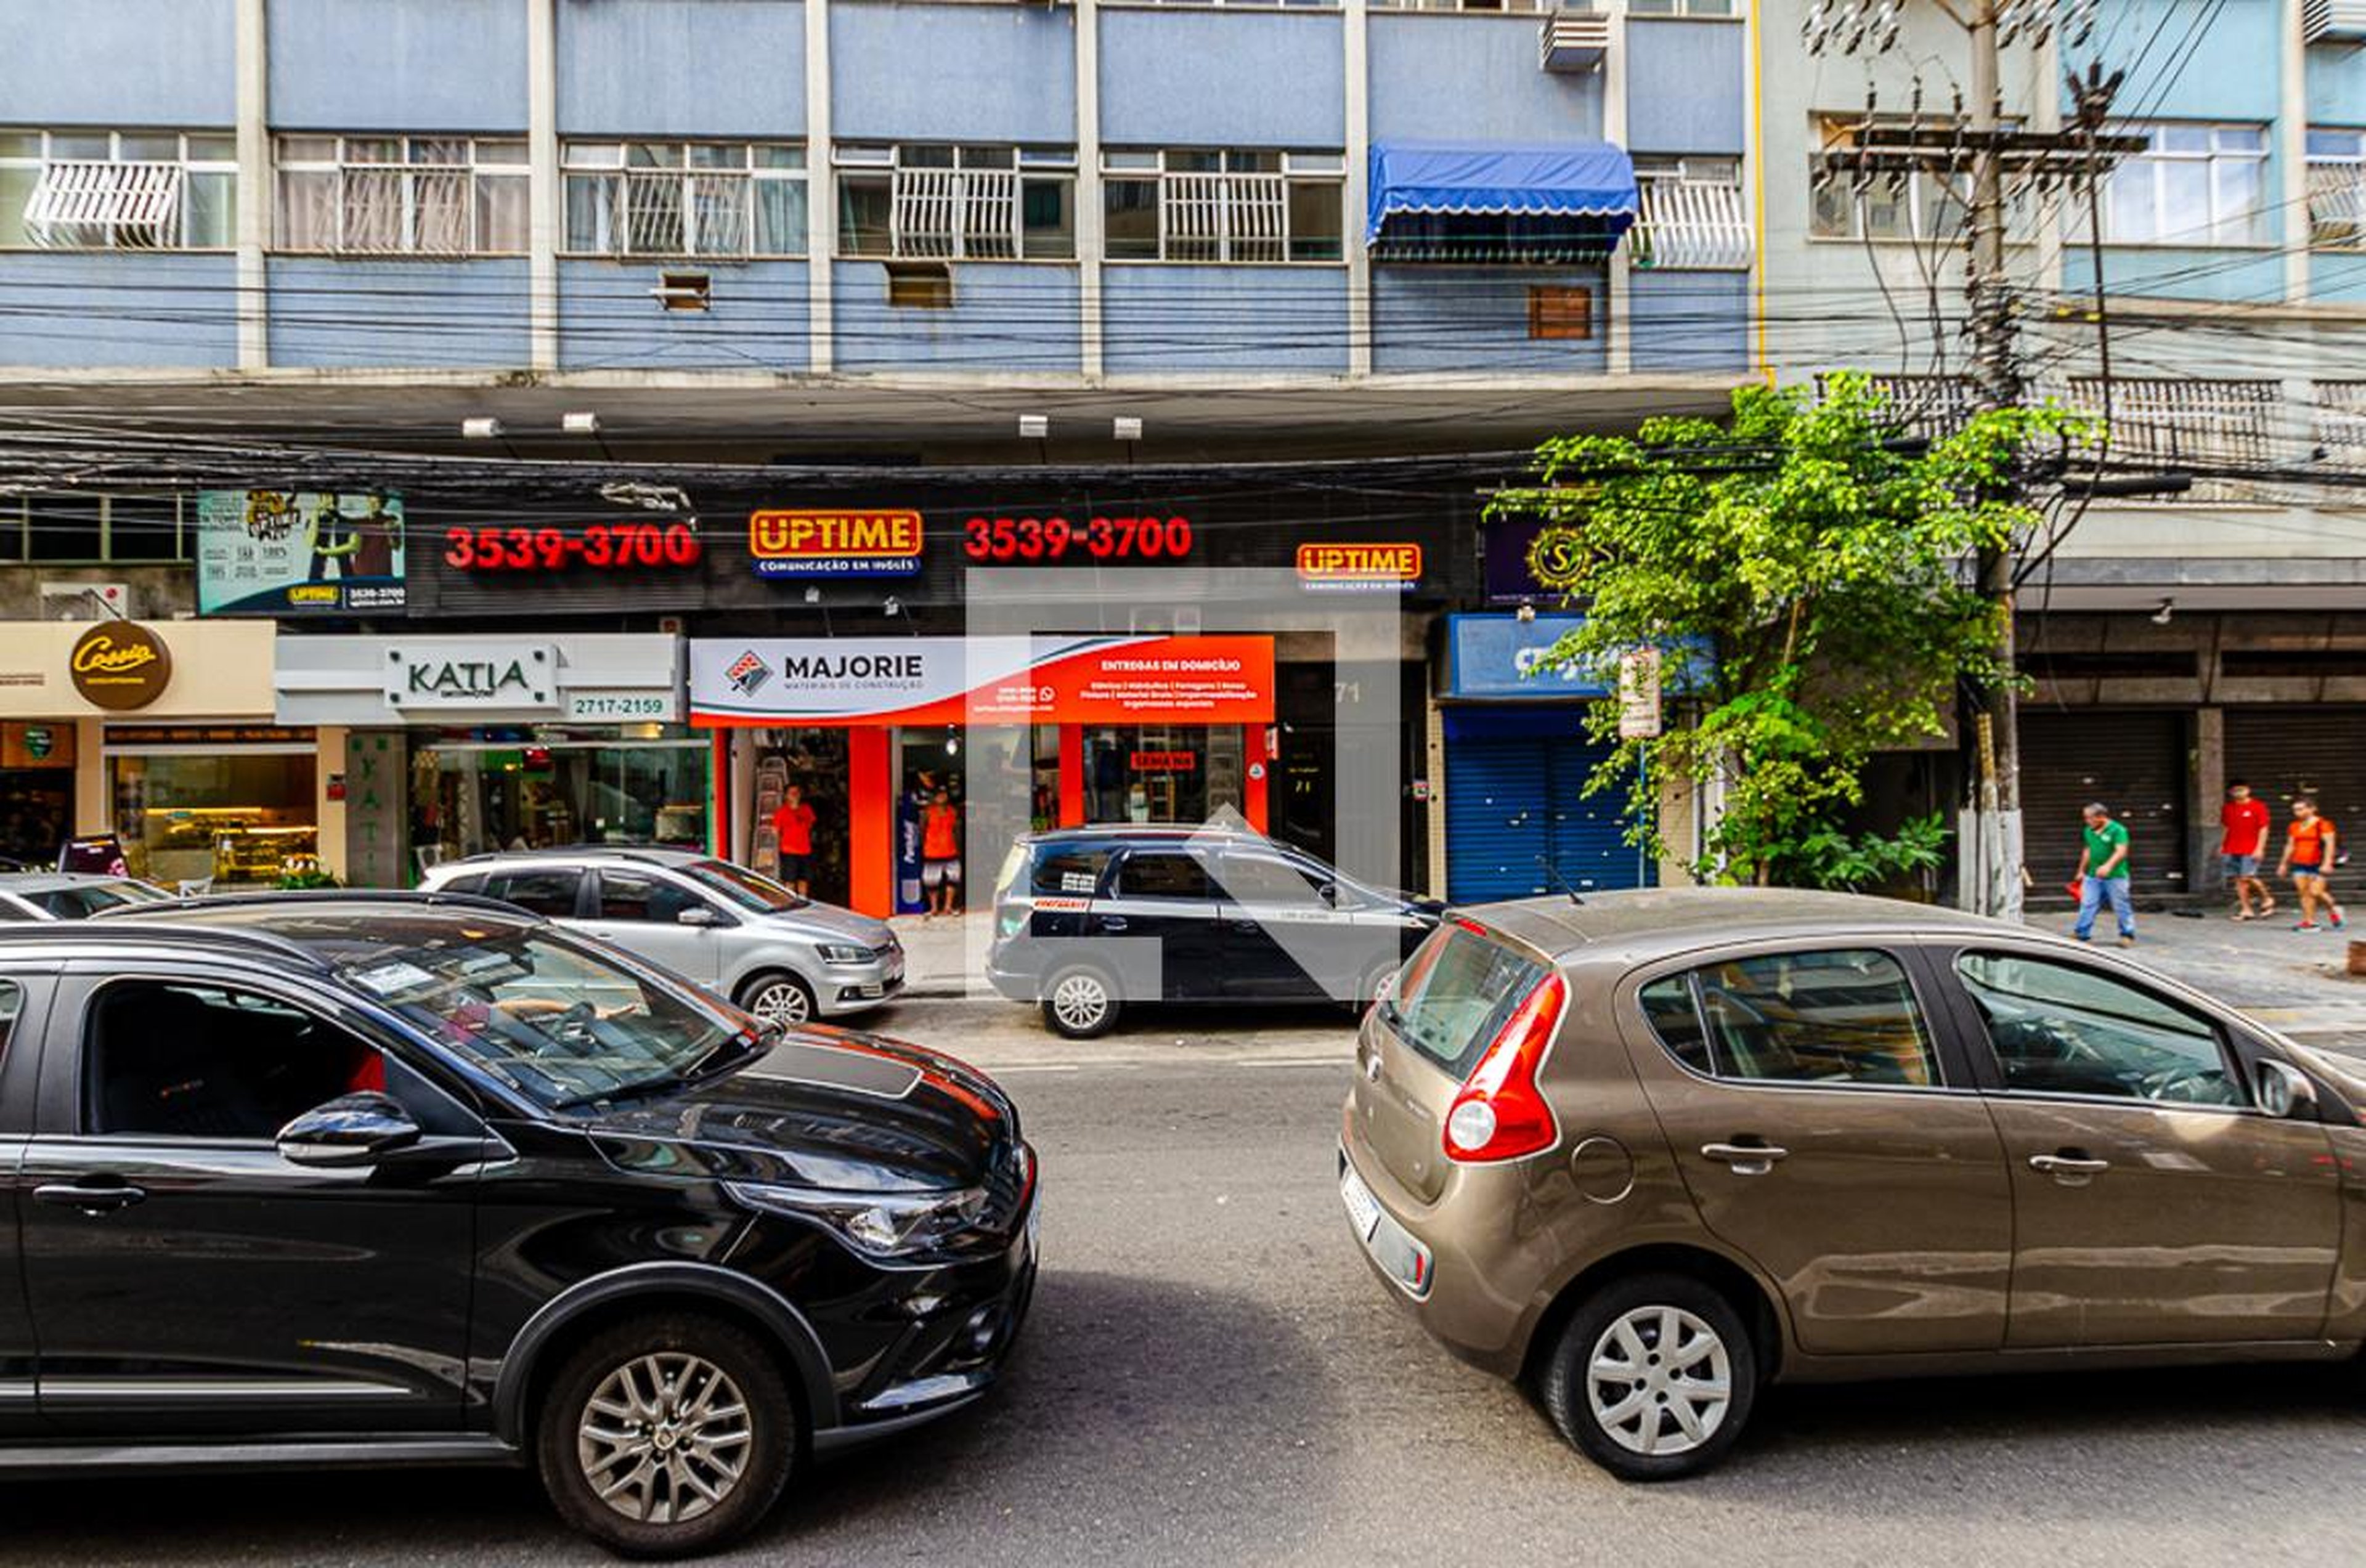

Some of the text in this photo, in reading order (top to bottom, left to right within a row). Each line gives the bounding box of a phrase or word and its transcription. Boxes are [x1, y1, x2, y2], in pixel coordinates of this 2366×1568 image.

[758, 518, 911, 550] UPTIME
[963, 517, 1193, 558] 3539-3700
[444, 525, 699, 569] 3539-3700
[759, 557, 914, 573] COMUNICAÇÃO EM INGLÊS
[1304, 549, 1415, 572] UPTIME
[409, 660, 529, 692] KATIA
[786, 656, 922, 678] MAJORIE
[1100, 660, 1160, 671] ENTREGAS
[1162, 660, 1178, 671] EM
[1335, 682, 1359, 704] 71
[575, 699, 664, 713] 2717-2159
